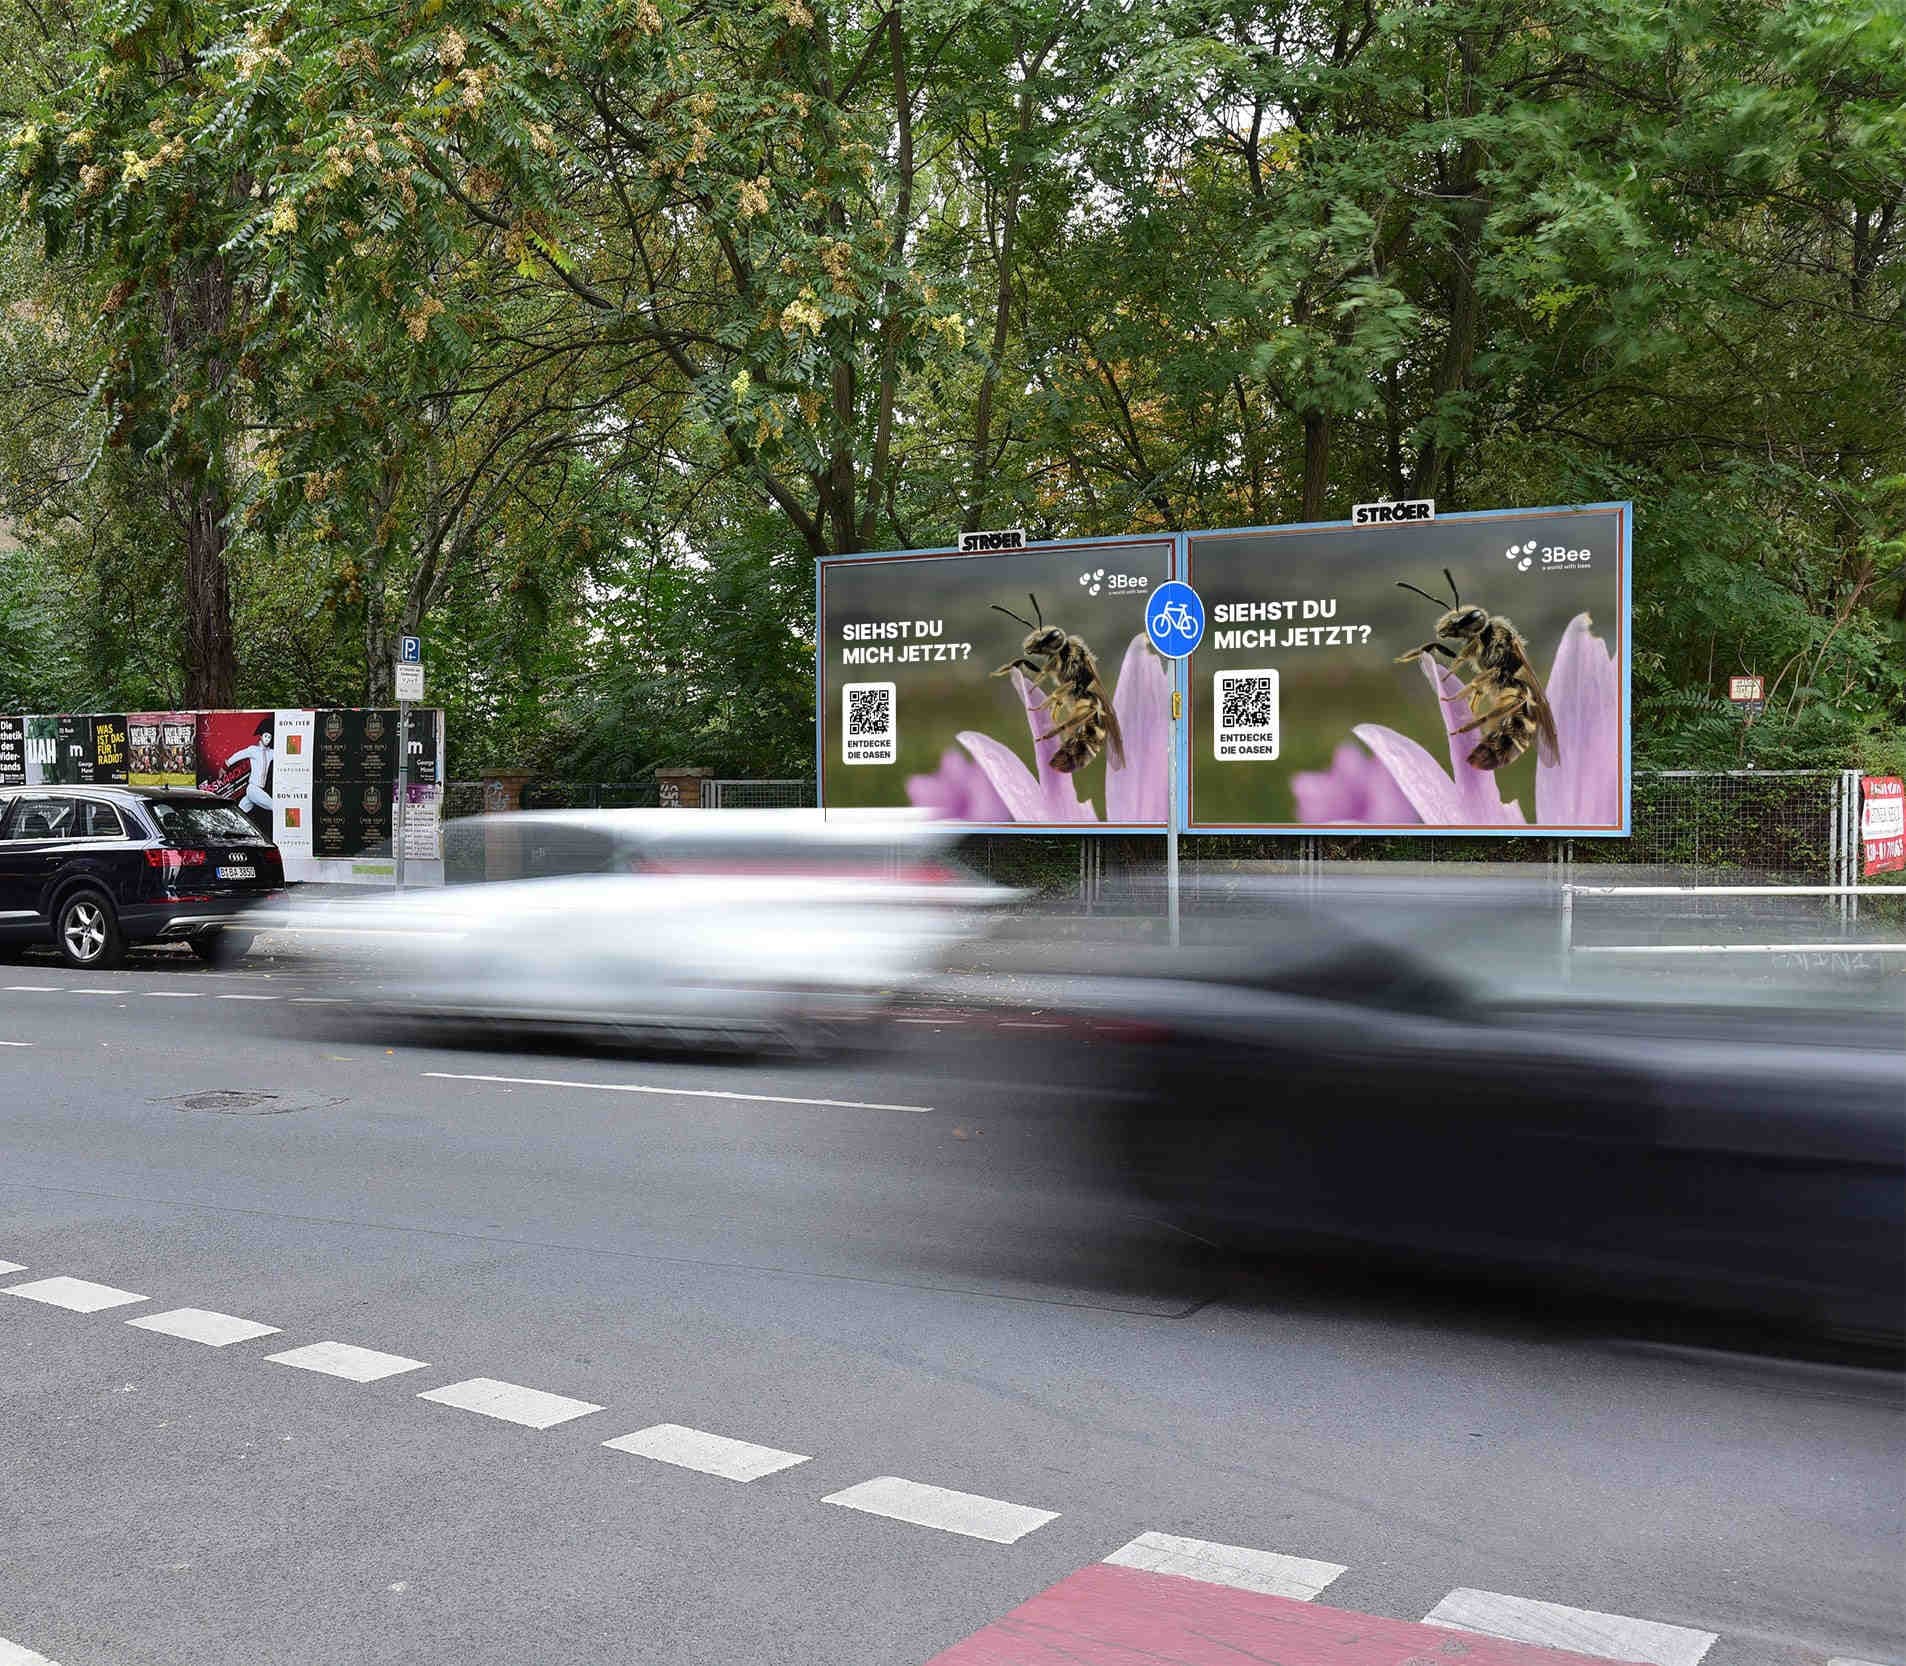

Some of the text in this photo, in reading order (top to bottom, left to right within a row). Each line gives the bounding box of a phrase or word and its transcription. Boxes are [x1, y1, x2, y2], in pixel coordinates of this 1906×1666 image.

[1356, 503, 1430, 523] STRÖER
[962, 532, 1022, 551] STRÖER
[1541, 546, 1591, 563] 3Bee
[1108, 574, 1148, 589] 3Bee
[1214, 599, 1337, 623] SIEHST DU
[842, 619, 943, 641] SIEHST DU
[1214, 625, 1372, 650] MICH JETZT?
[405, 640, 416, 660] P
[842, 643, 972, 665] MICH JETZT?
[0, 721, 13, 730] Die
[96, 723, 113, 735] WAS
[279, 719, 310, 727] BON IVER
[97, 732, 125, 745] IST DAS
[848, 739, 892, 748] ENTDECKE
[1220, 733, 1273, 743] ENTDECKE
[0, 742, 14, 751] des
[69, 744, 83, 757] m
[1220, 745, 1273, 755] DIE OASEN
[98, 752, 123, 765] RADIO?
[847, 750, 891, 760] DIE OASEN
